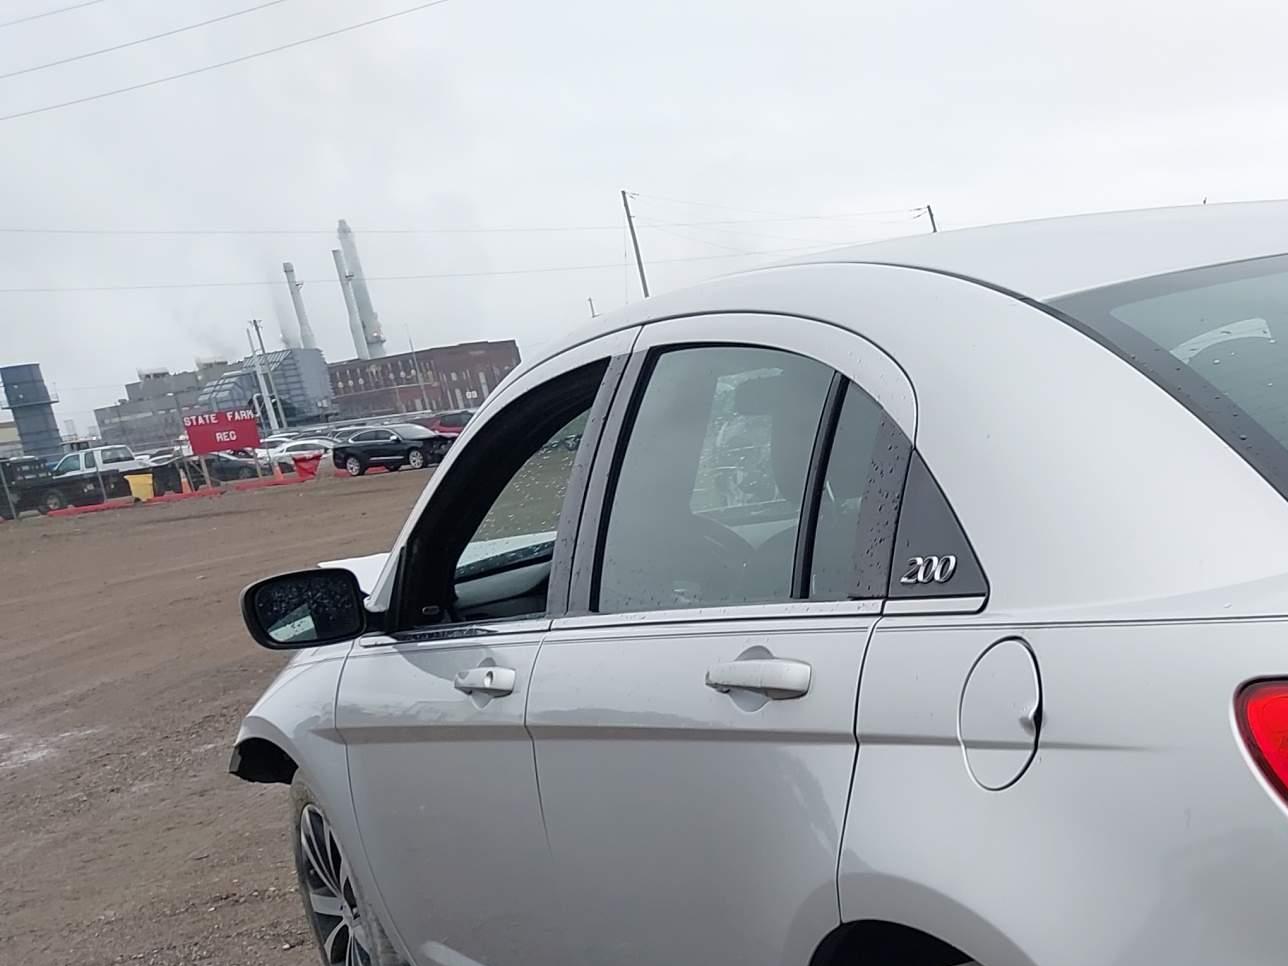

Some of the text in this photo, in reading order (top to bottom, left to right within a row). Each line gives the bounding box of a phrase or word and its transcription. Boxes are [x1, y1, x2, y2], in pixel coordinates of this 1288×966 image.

[183, 409, 254, 426] STATE FARM
[899, 554, 957, 583] 200
